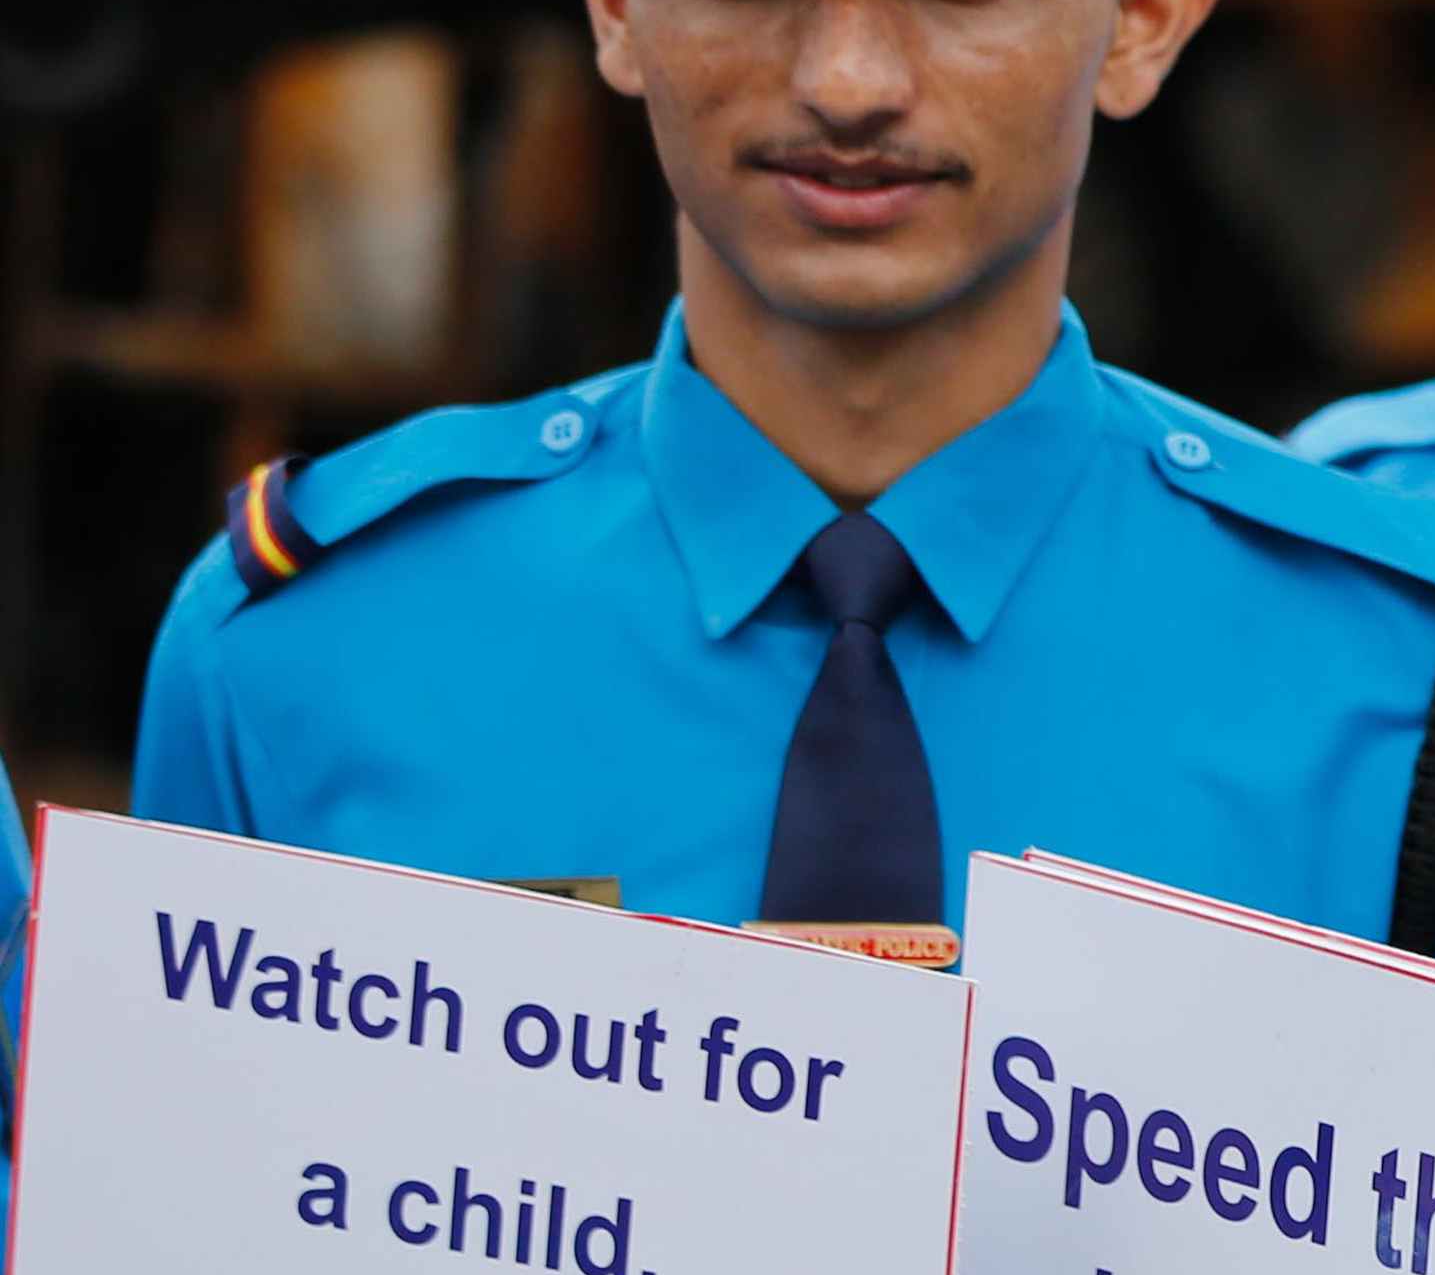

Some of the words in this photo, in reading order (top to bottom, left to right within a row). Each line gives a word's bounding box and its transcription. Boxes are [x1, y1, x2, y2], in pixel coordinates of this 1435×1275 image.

[156, 912, 462, 1052] Watch
[504, 1004, 666, 1091] out
[700, 1017, 844, 1121] for
[298, 1163, 347, 1230] a
[986, 1037, 1334, 1246] Speed
